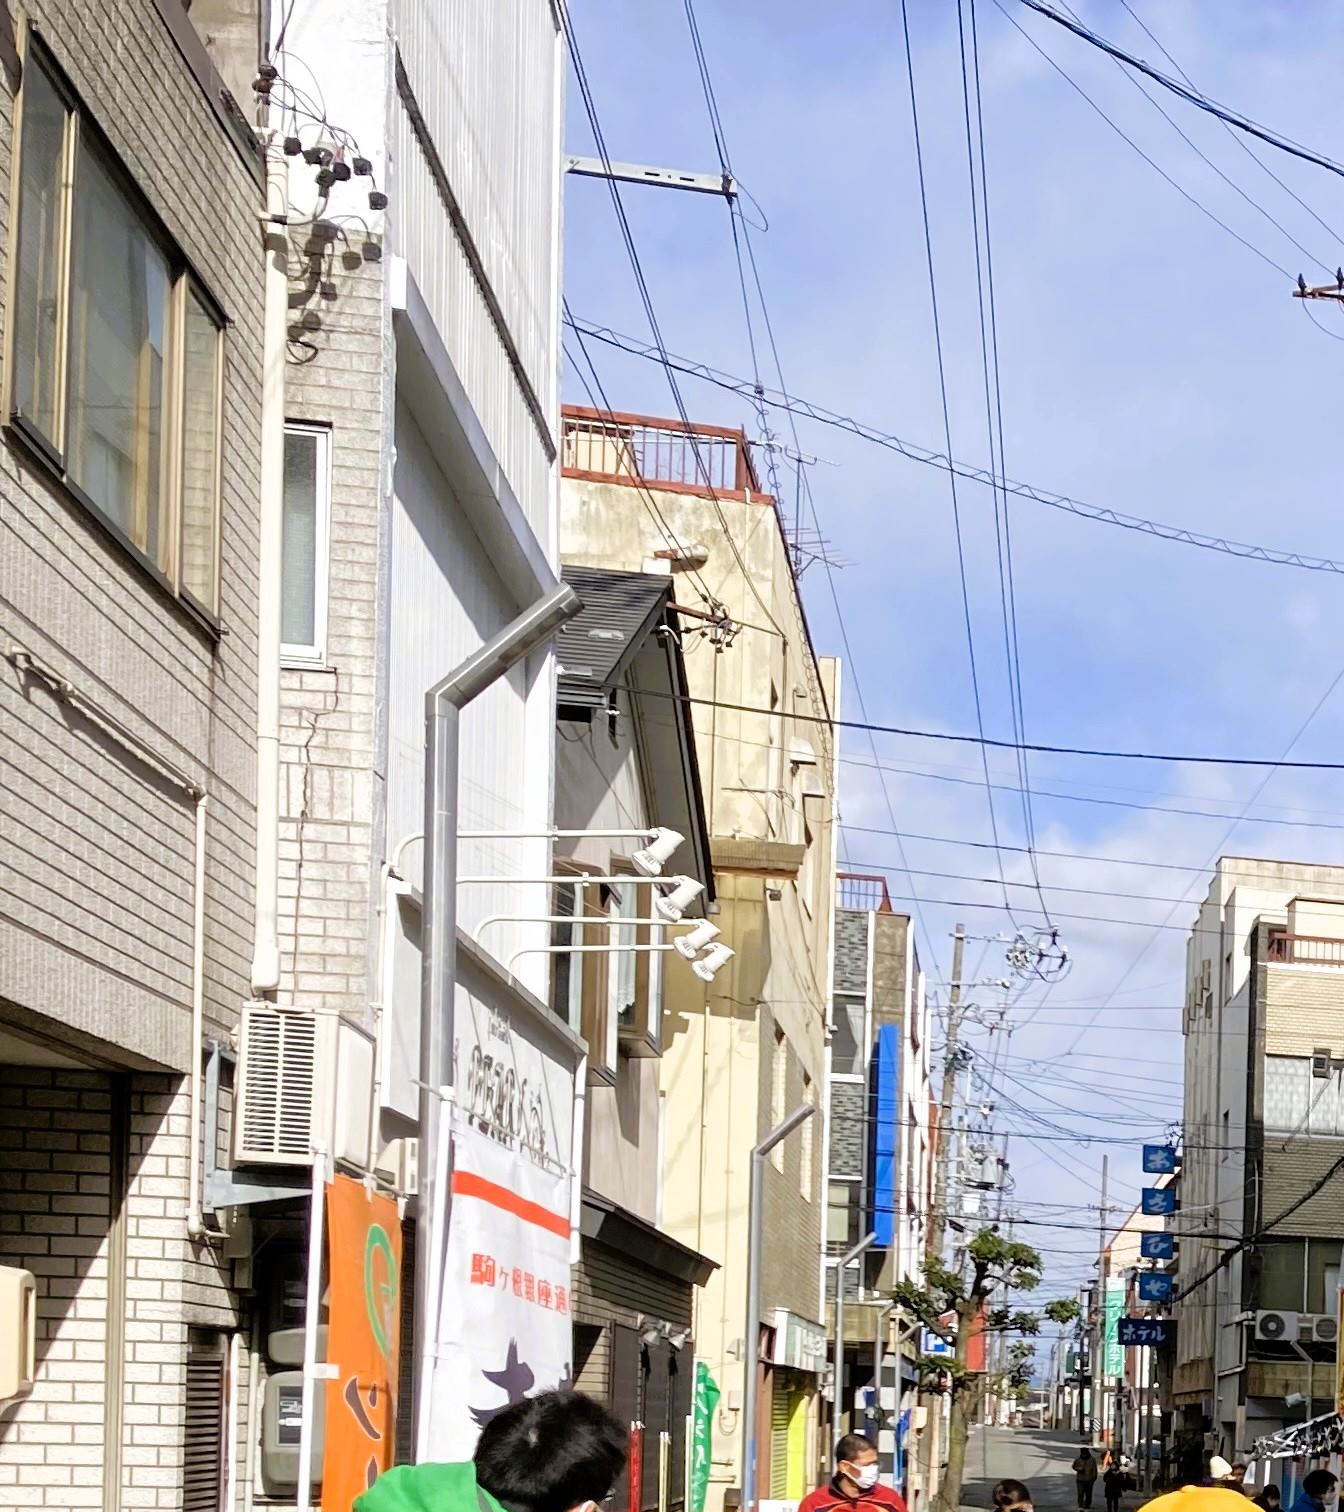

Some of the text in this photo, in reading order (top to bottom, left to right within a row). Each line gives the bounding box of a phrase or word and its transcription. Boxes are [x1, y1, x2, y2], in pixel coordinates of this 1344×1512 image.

[470, 1253, 570, 1316] 駒ヶ根銀座通
[1122, 1323, 1166, 1342] ホテル
